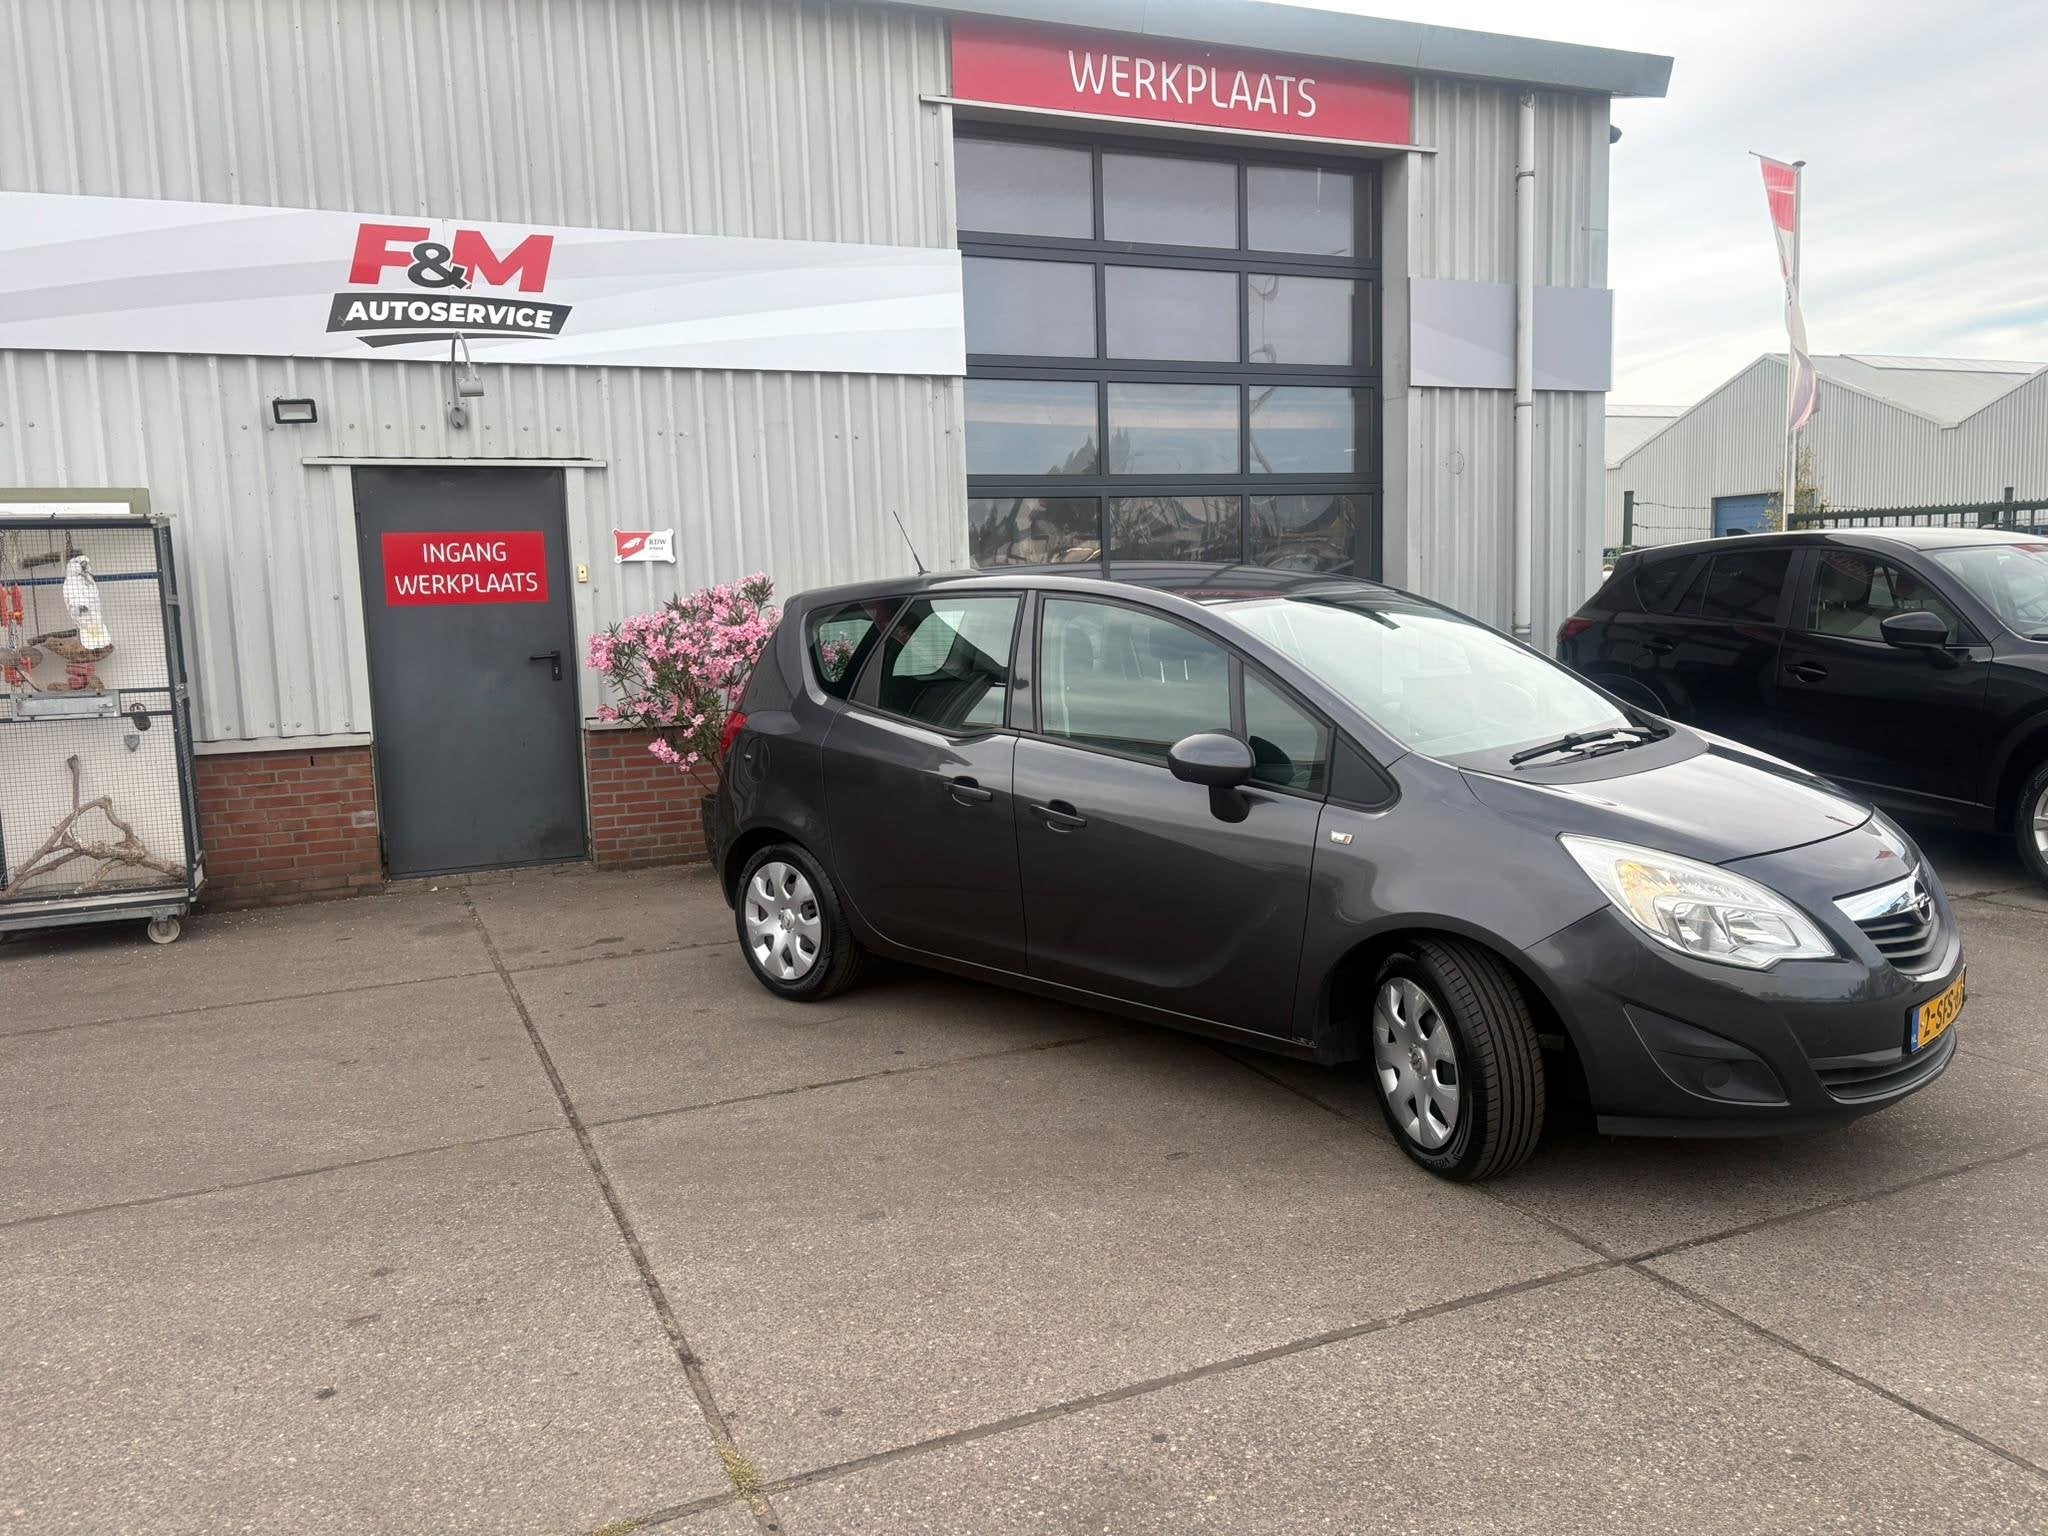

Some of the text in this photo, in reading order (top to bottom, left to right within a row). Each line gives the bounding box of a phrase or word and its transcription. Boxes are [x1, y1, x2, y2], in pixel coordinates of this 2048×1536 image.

[1068, 50, 1317, 118] WERKPLAATS
[348, 223, 554, 293] F&M
[345, 300, 554, 330] AUTOSERVICE
[422, 542, 507, 563] INGANG
[394, 572, 539, 595] WERKPLAATS
